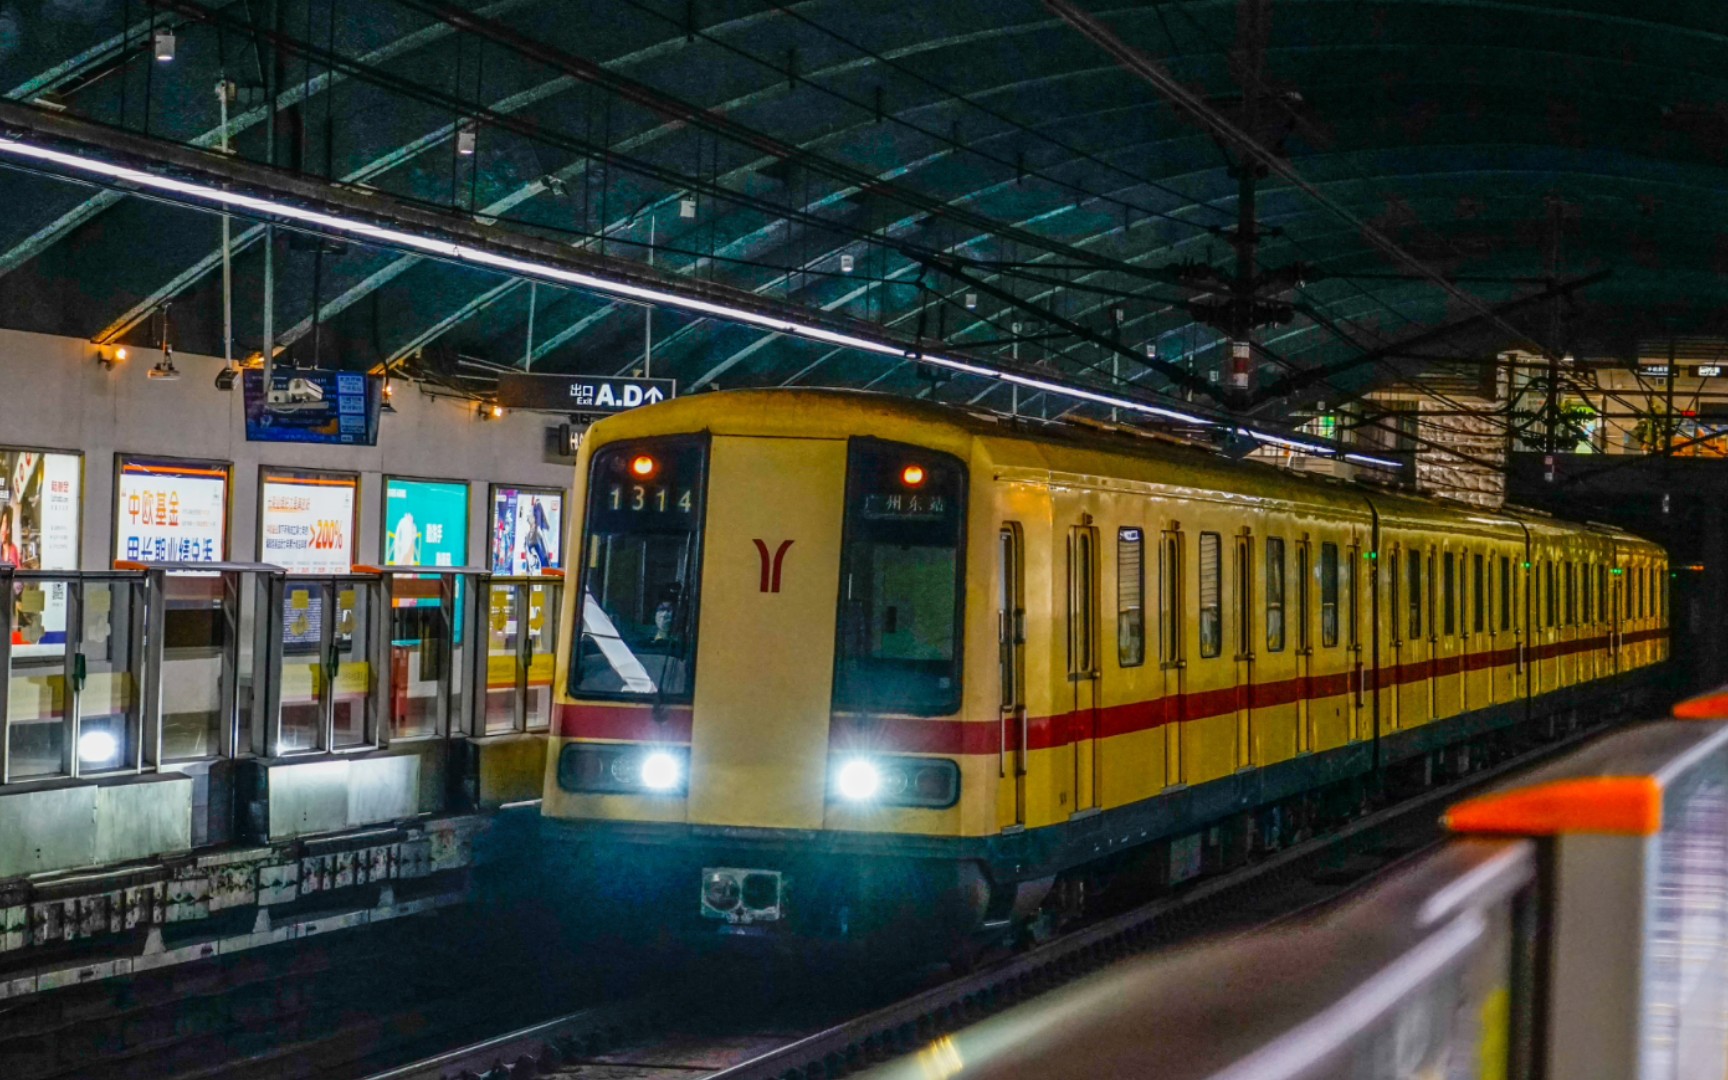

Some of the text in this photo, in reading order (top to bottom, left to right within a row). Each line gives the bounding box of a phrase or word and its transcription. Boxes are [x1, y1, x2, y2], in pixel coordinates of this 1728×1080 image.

[570, 383, 594, 397] 出口
[577, 397, 592, 406] Exit
[128, 489, 179, 526] 中欧基金
[610, 485, 692, 513] 1314
[864, 494, 944, 512] 广州东站
